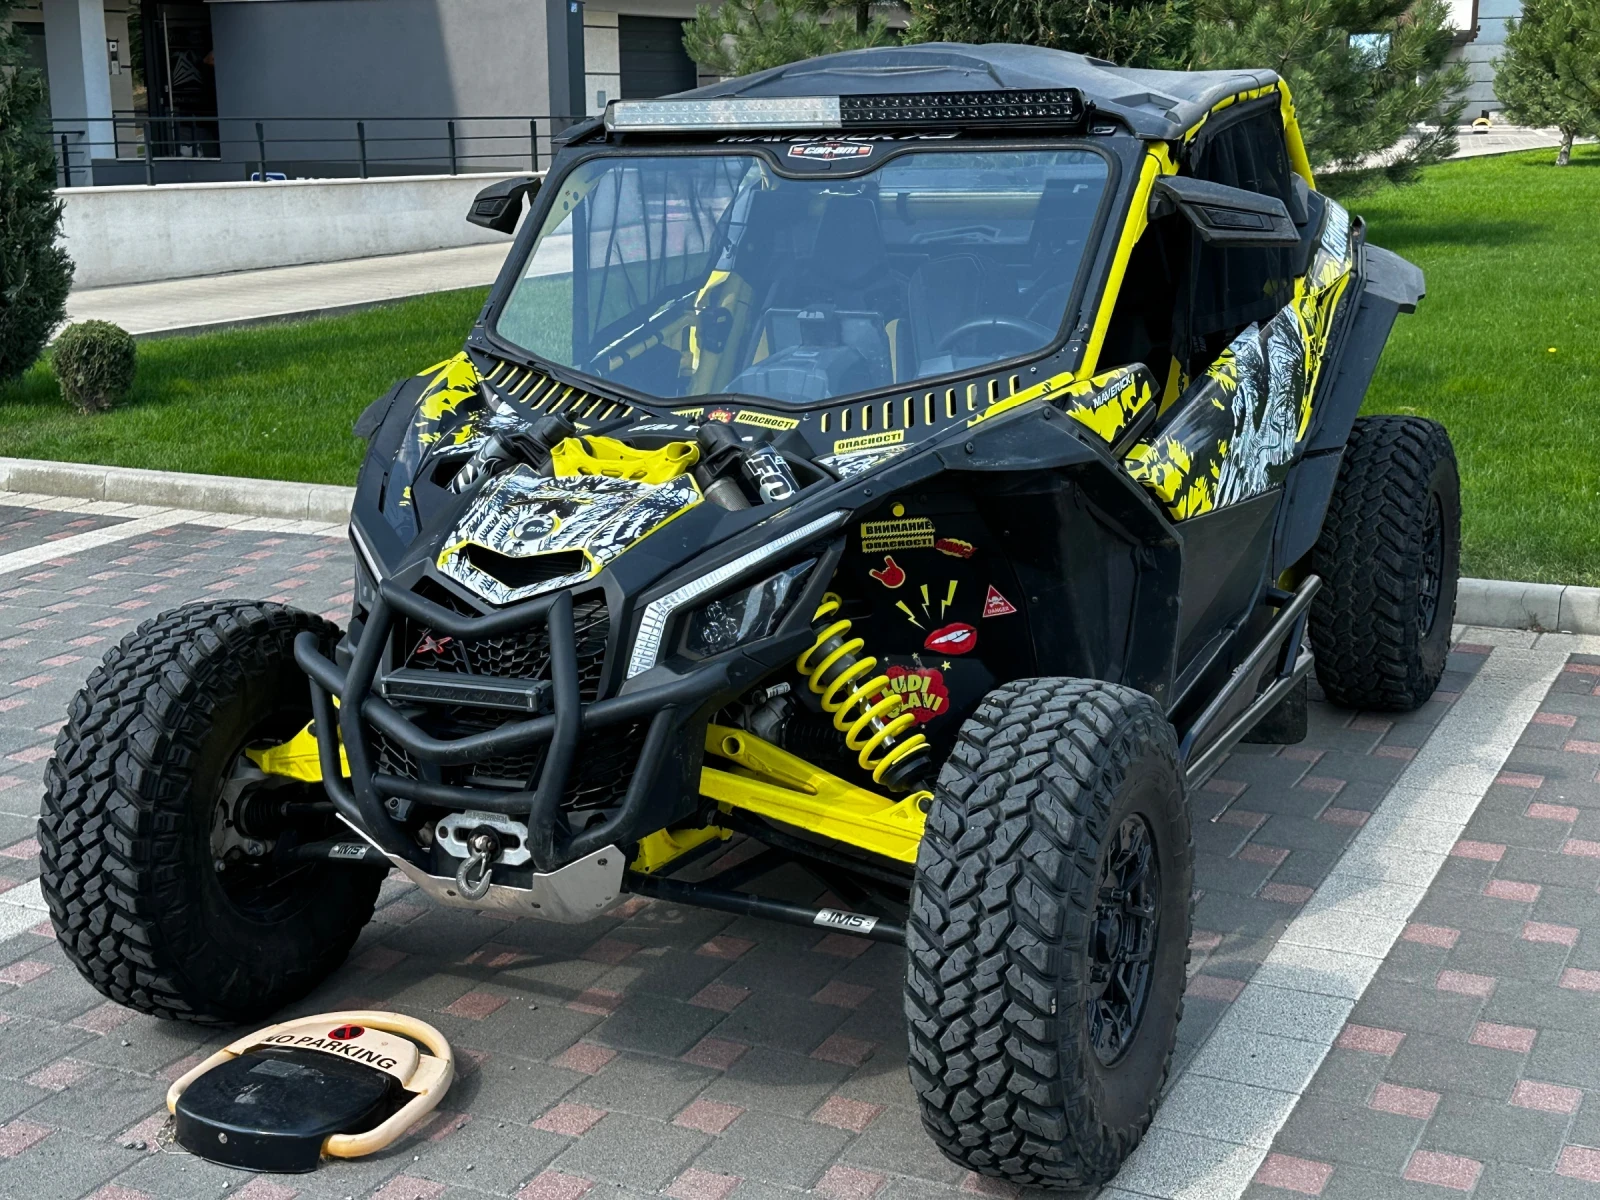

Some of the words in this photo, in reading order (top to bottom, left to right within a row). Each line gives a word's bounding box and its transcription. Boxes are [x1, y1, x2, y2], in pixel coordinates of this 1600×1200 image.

[1092, 373, 1132, 409] MAVERICK
[745, 454, 797, 504] FO
[987, 606, 1010, 614] DANGER
[827, 911, 866, 927] IMS
[265, 1034, 295, 1044] NO
[293, 1036, 398, 1070] PARKING
